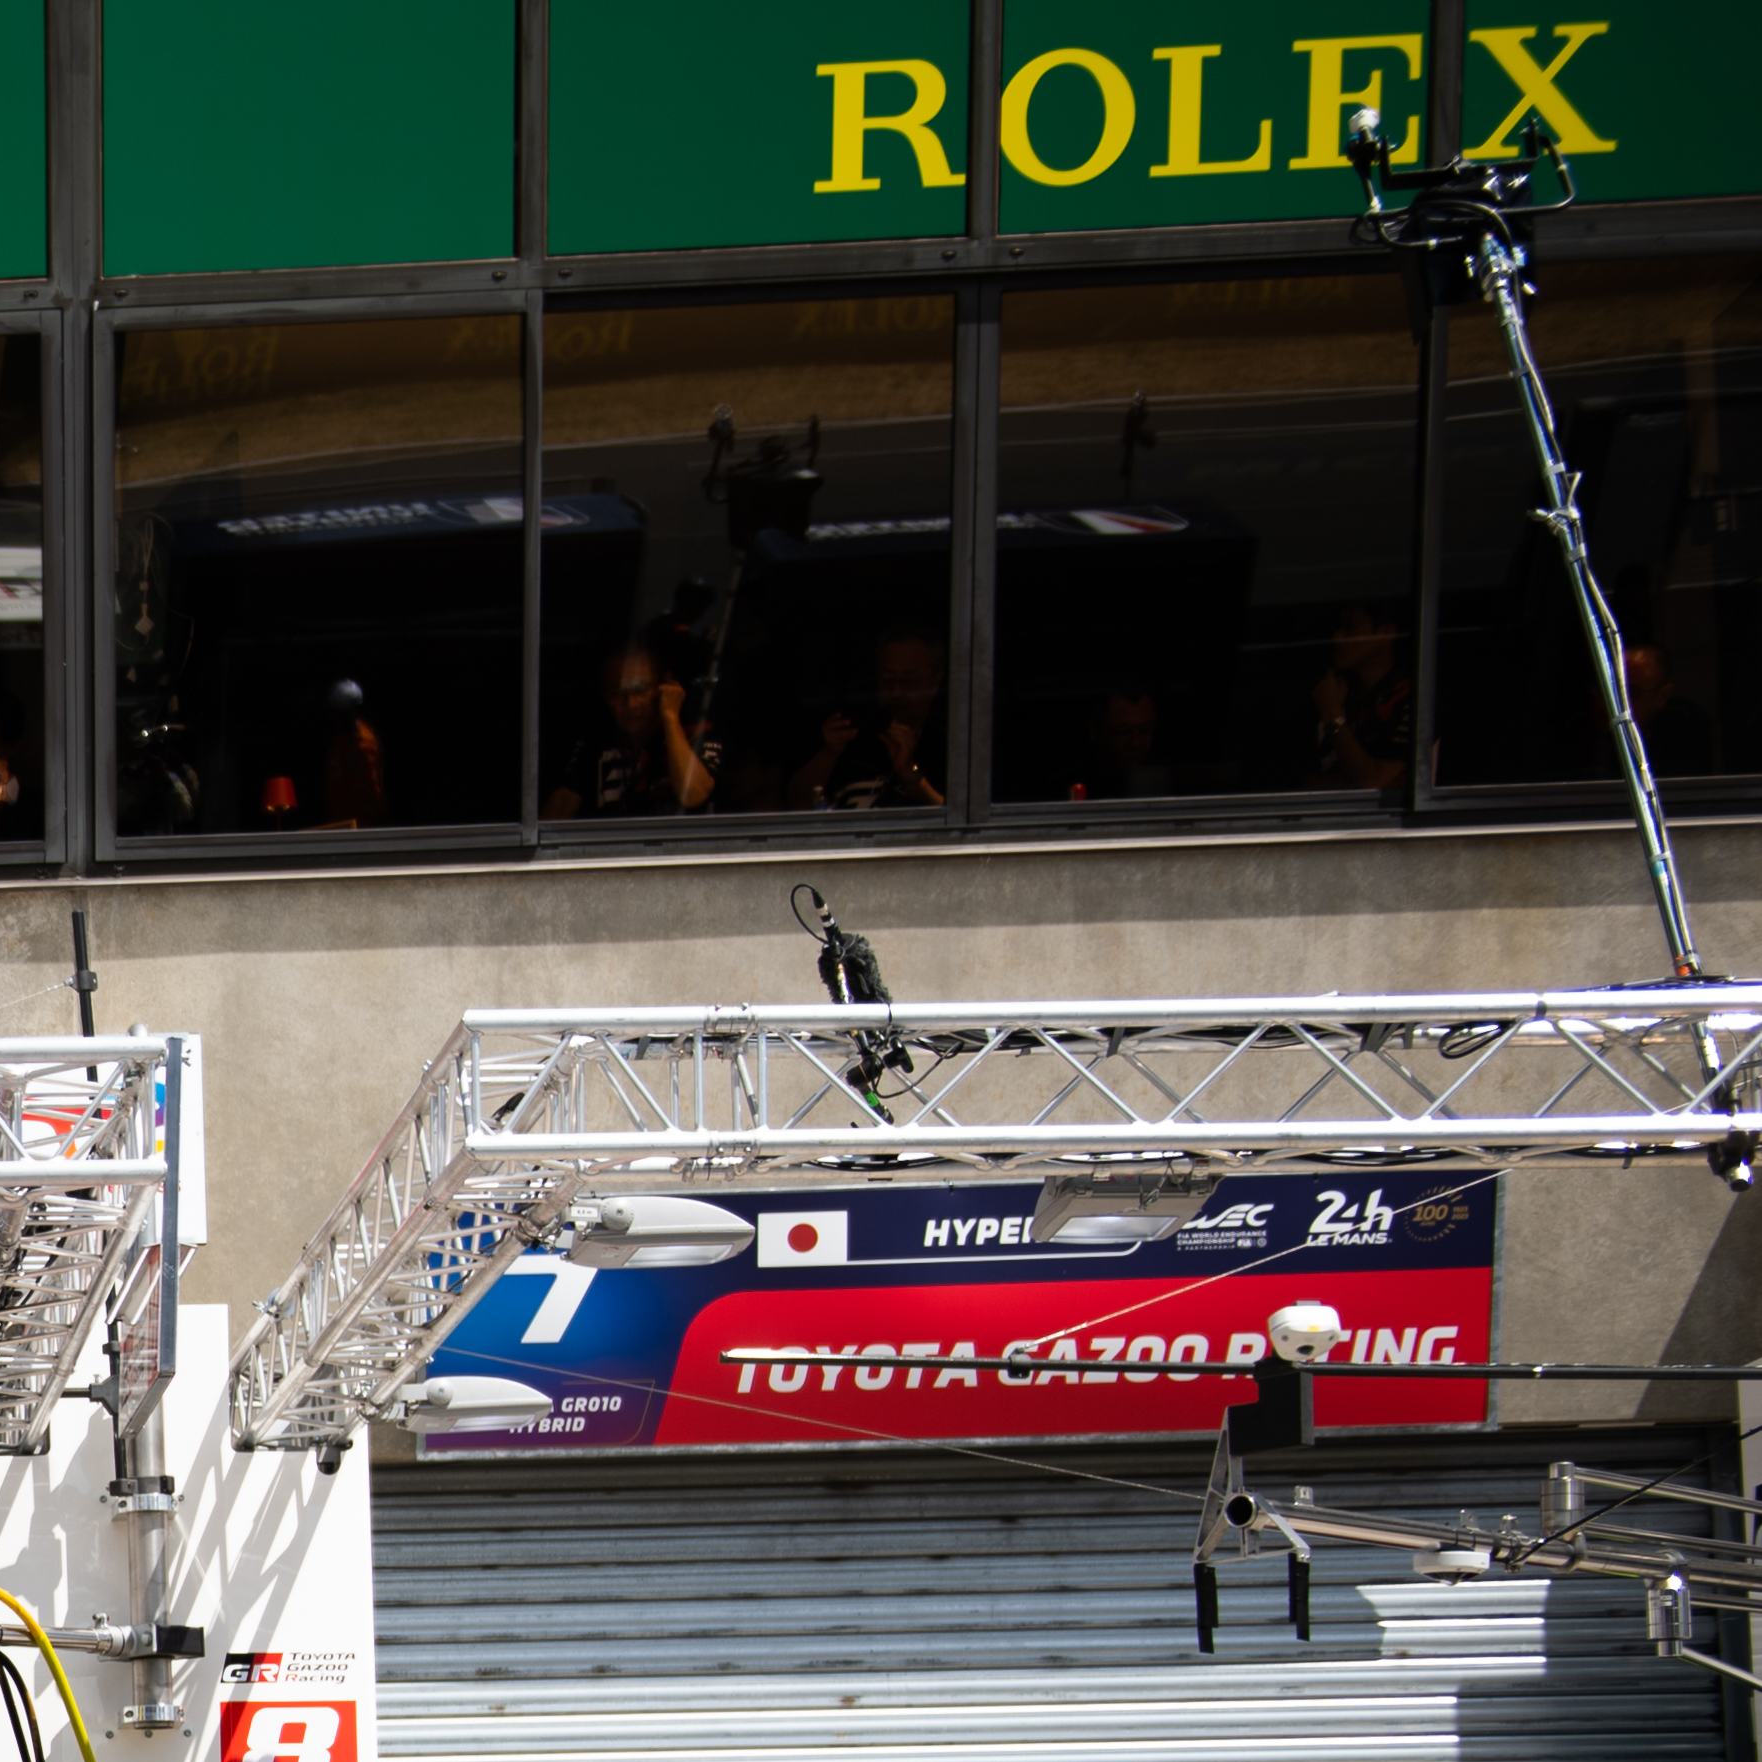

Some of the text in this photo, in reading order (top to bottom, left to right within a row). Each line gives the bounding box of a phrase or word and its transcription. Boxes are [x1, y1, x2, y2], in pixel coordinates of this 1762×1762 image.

[814, 22, 1618, 192] ROLEX
[1413, 1204, 1449, 1222] 100
[1306, 1232, 1389, 1247] LE MANS
[504, 1254, 599, 1344] 7
[998, 1335, 1213, 1386] GAZOO
[562, 1396, 622, 1413] GR010
[222, 1652, 355, 1683] GR TOYOTA
[287, 1663, 349, 1672] GAZOO
[284, 1673, 346, 1685] Racing
